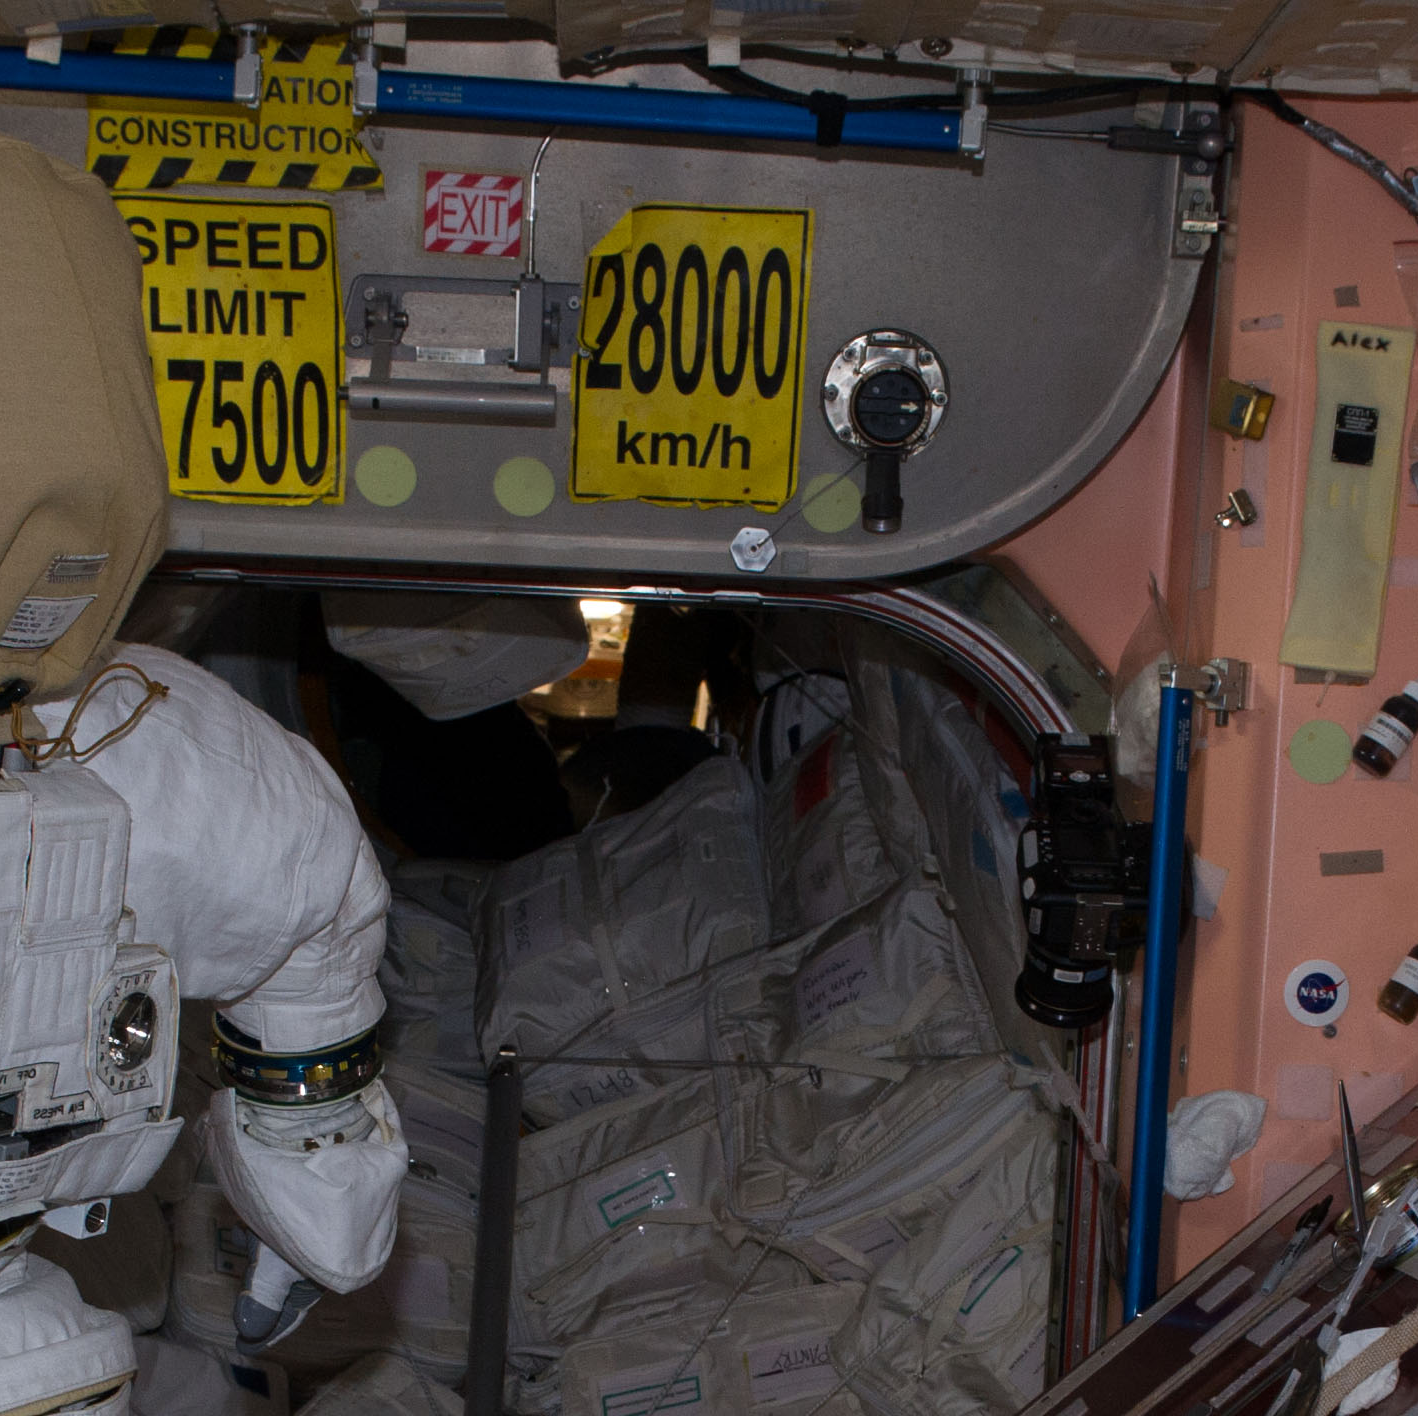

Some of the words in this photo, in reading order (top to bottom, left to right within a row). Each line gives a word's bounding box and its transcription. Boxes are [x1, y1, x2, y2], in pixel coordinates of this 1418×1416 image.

[95, 116, 363, 155] CONSTRUCTION
[440, 193, 507, 237] EXIT
[126, 216, 328, 271] SPEED
[149, 287, 306, 337] LIMIT
[585, 242, 792, 399] 28000
[1331, 330, 1392, 352] Alex
[151, 358, 329, 487] 7500
[616, 420, 751, 470] km/h
[1299, 986, 1335, 1001] NASA
